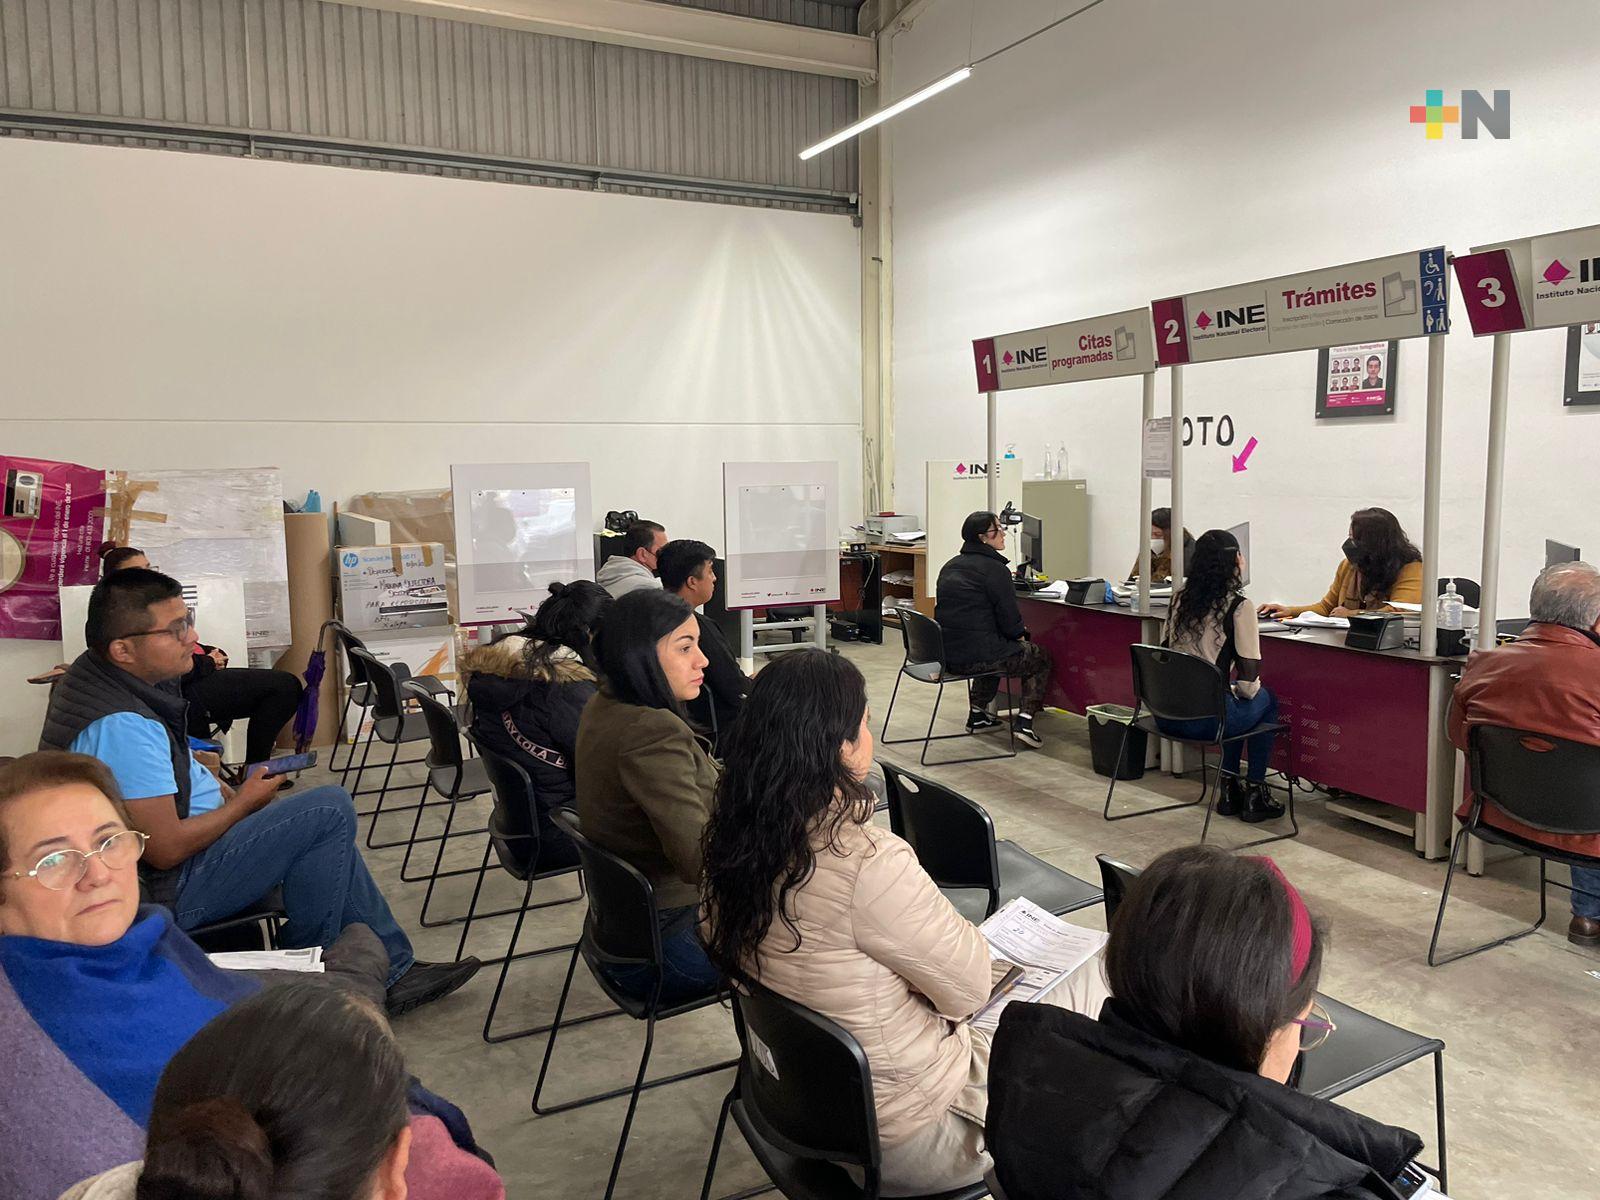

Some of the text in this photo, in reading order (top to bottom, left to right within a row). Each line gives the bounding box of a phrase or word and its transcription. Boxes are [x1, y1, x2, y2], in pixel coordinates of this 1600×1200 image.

[1282, 281, 1377, 309] Trámites
[1477, 277, 1506, 308] 3
[1536, 288, 1574, 300] Instituto
[1216, 303, 1266, 329] INE
[1164, 319, 1181, 345] 2
[1078, 334, 1112, 351] Citas
[982, 354, 992, 375] 1
[1015, 346, 1047, 365] INE
[1051, 350, 1114, 370] programadas
[343, 552, 359, 569] hp
